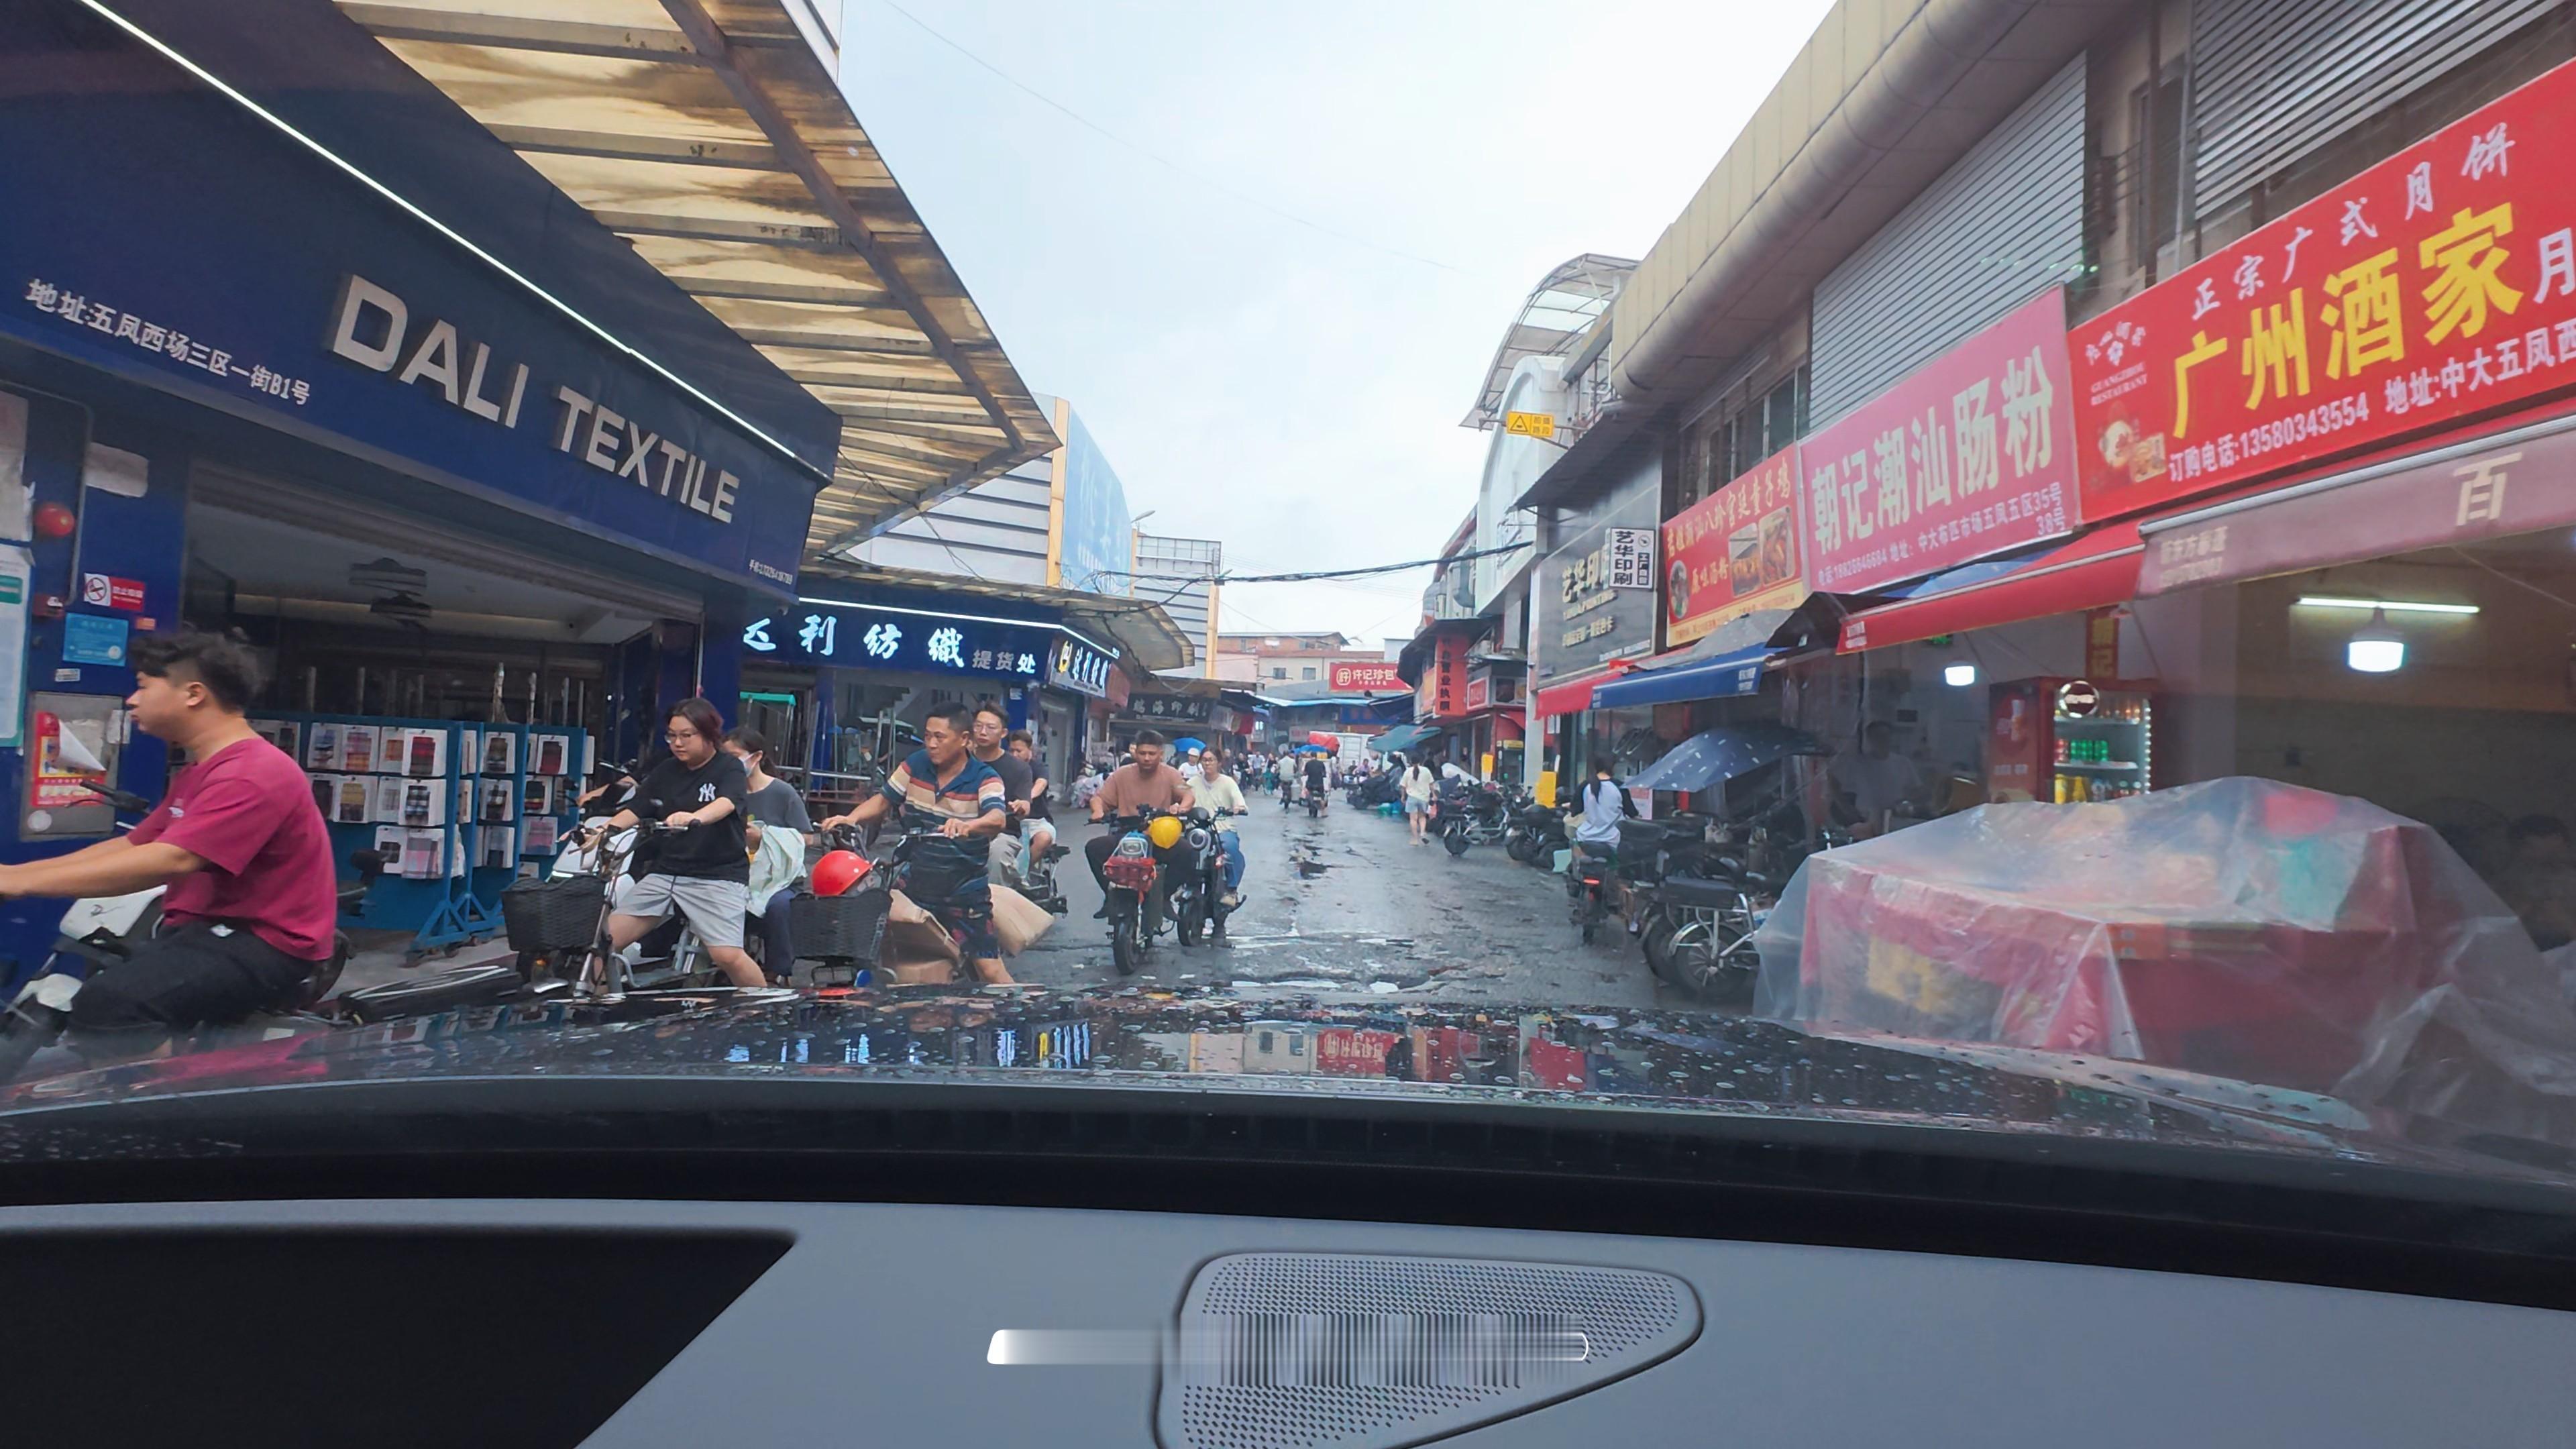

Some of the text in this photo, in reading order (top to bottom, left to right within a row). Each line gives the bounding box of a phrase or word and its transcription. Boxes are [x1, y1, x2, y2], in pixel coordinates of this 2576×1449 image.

[2192, 122, 2516, 321] 正宗广式月饼
[2172, 202, 2524, 440] 广州酒家
[333, 274, 739, 523] DALI TEXTILE
[2091, 362, 2144, 393] GUANGZHOU
[2091, 374, 2147, 406] RESTAURANT
[1812, 345, 2054, 555] 朝记潮汕肠粉
[2169, 393, 2369, 482] 订购电话:13580343554
[2453, 451, 2523, 527] 百
[1613, 531, 1636, 586] 艺华印刷
[972, 649, 1036, 674] 提货处
[1352, 669, 1397, 681] 许记珍包
[698, 782, 716, 802] NY
